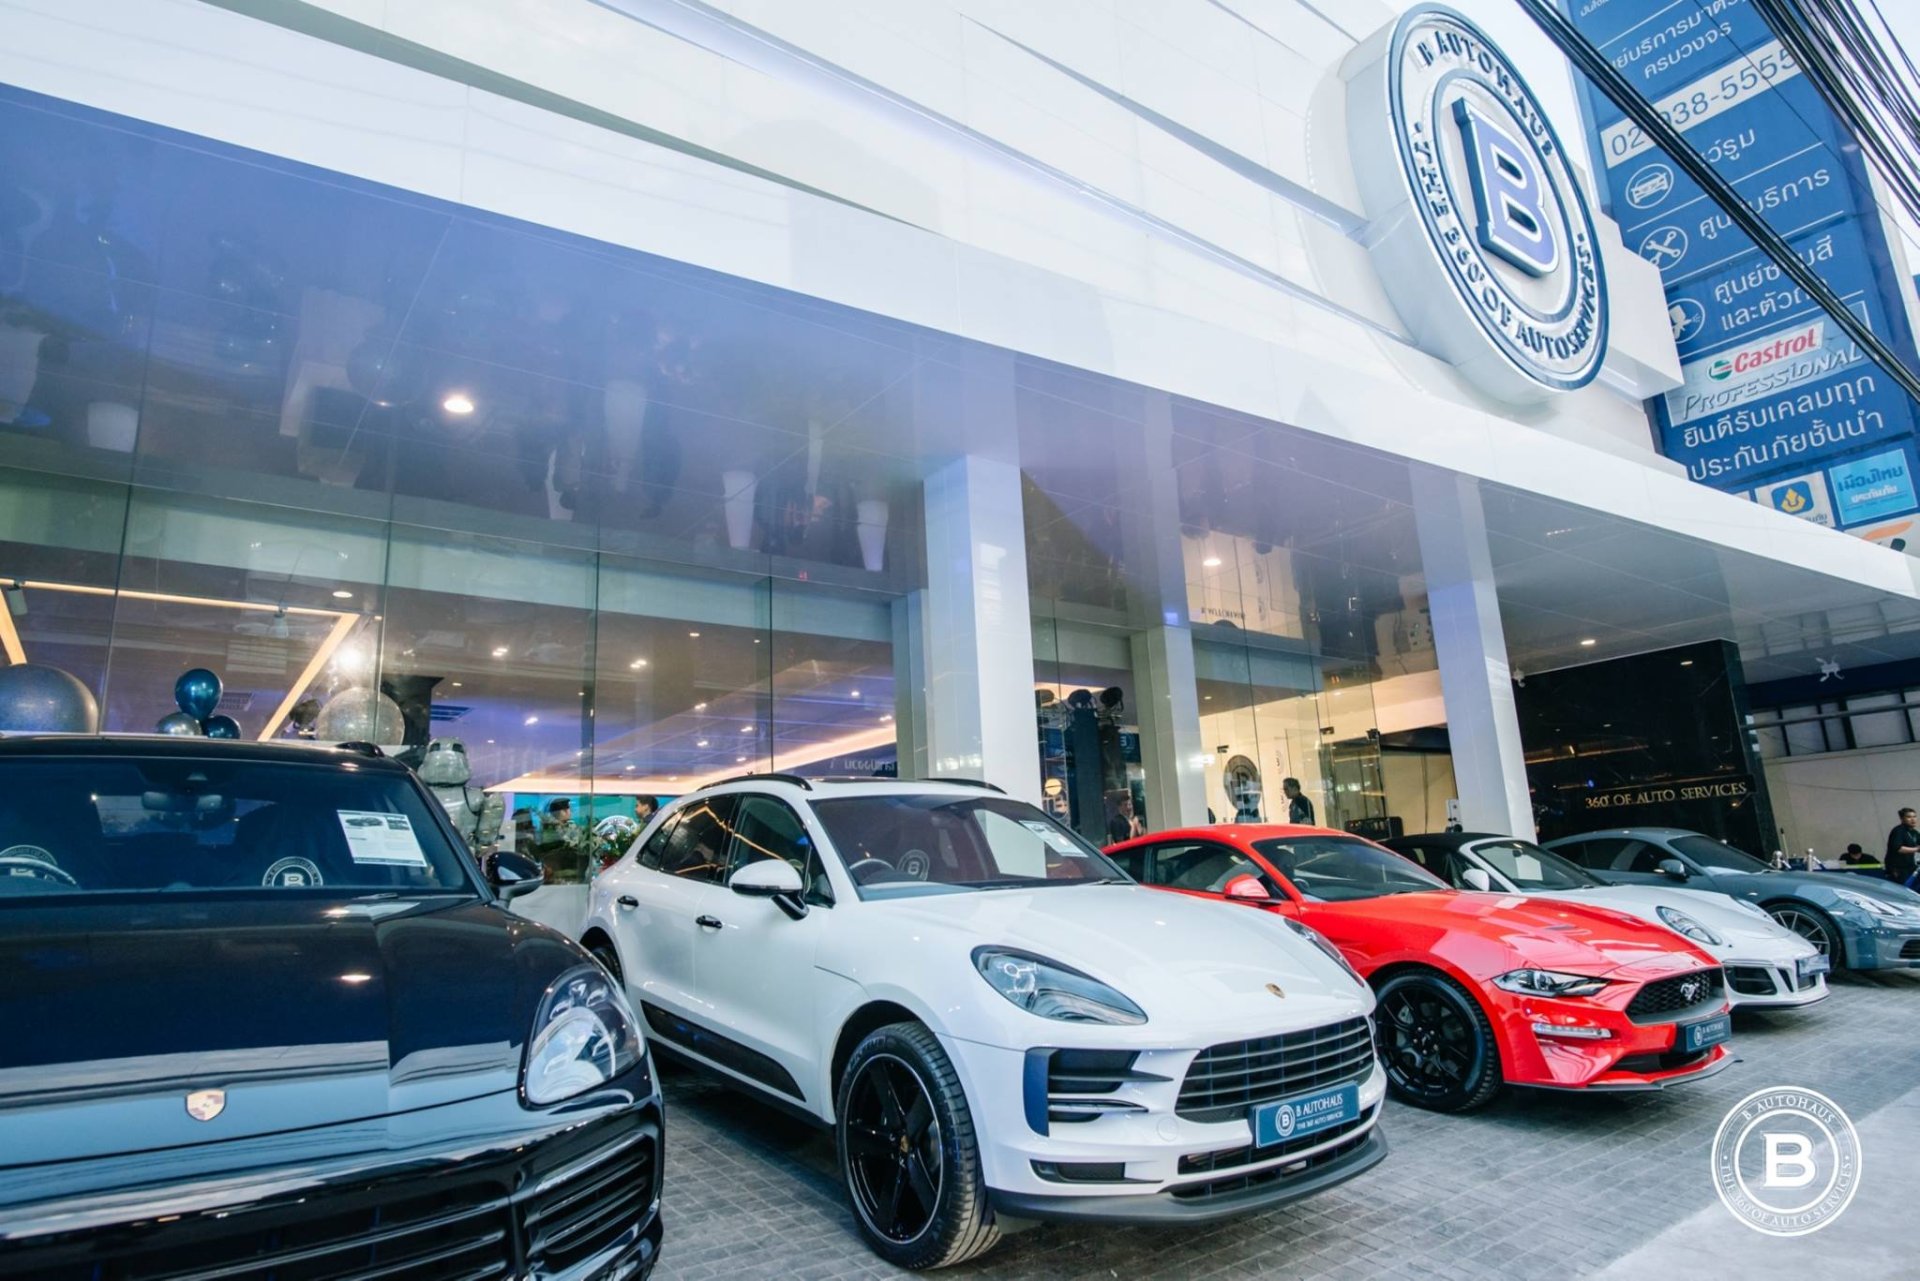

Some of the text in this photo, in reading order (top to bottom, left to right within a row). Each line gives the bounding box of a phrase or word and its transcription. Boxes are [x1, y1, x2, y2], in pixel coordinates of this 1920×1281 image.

[1417, 42, 1434, 66] B
[1644, 21, 1732, 79] ครบวงจร
[1453, 97, 1559, 276] B
[1414, 141, 1450, 217] THE
[1483, 287, 1512, 327] OF
[1516, 321, 1570, 360] AUTO
[1734, 327, 1816, 373] Castrol
[1684, 375, 1876, 448] ยินดีรับเคลมทุก
[1691, 410, 1884, 481] ประกันภัยชั้นนำ
[1613, 793, 1632, 806] OF
[1636, 789, 1676, 804] AUTO
[1681, 782, 1747, 800] SERVICES
[1303, 1093, 1343, 1116] AUTOHAUS
